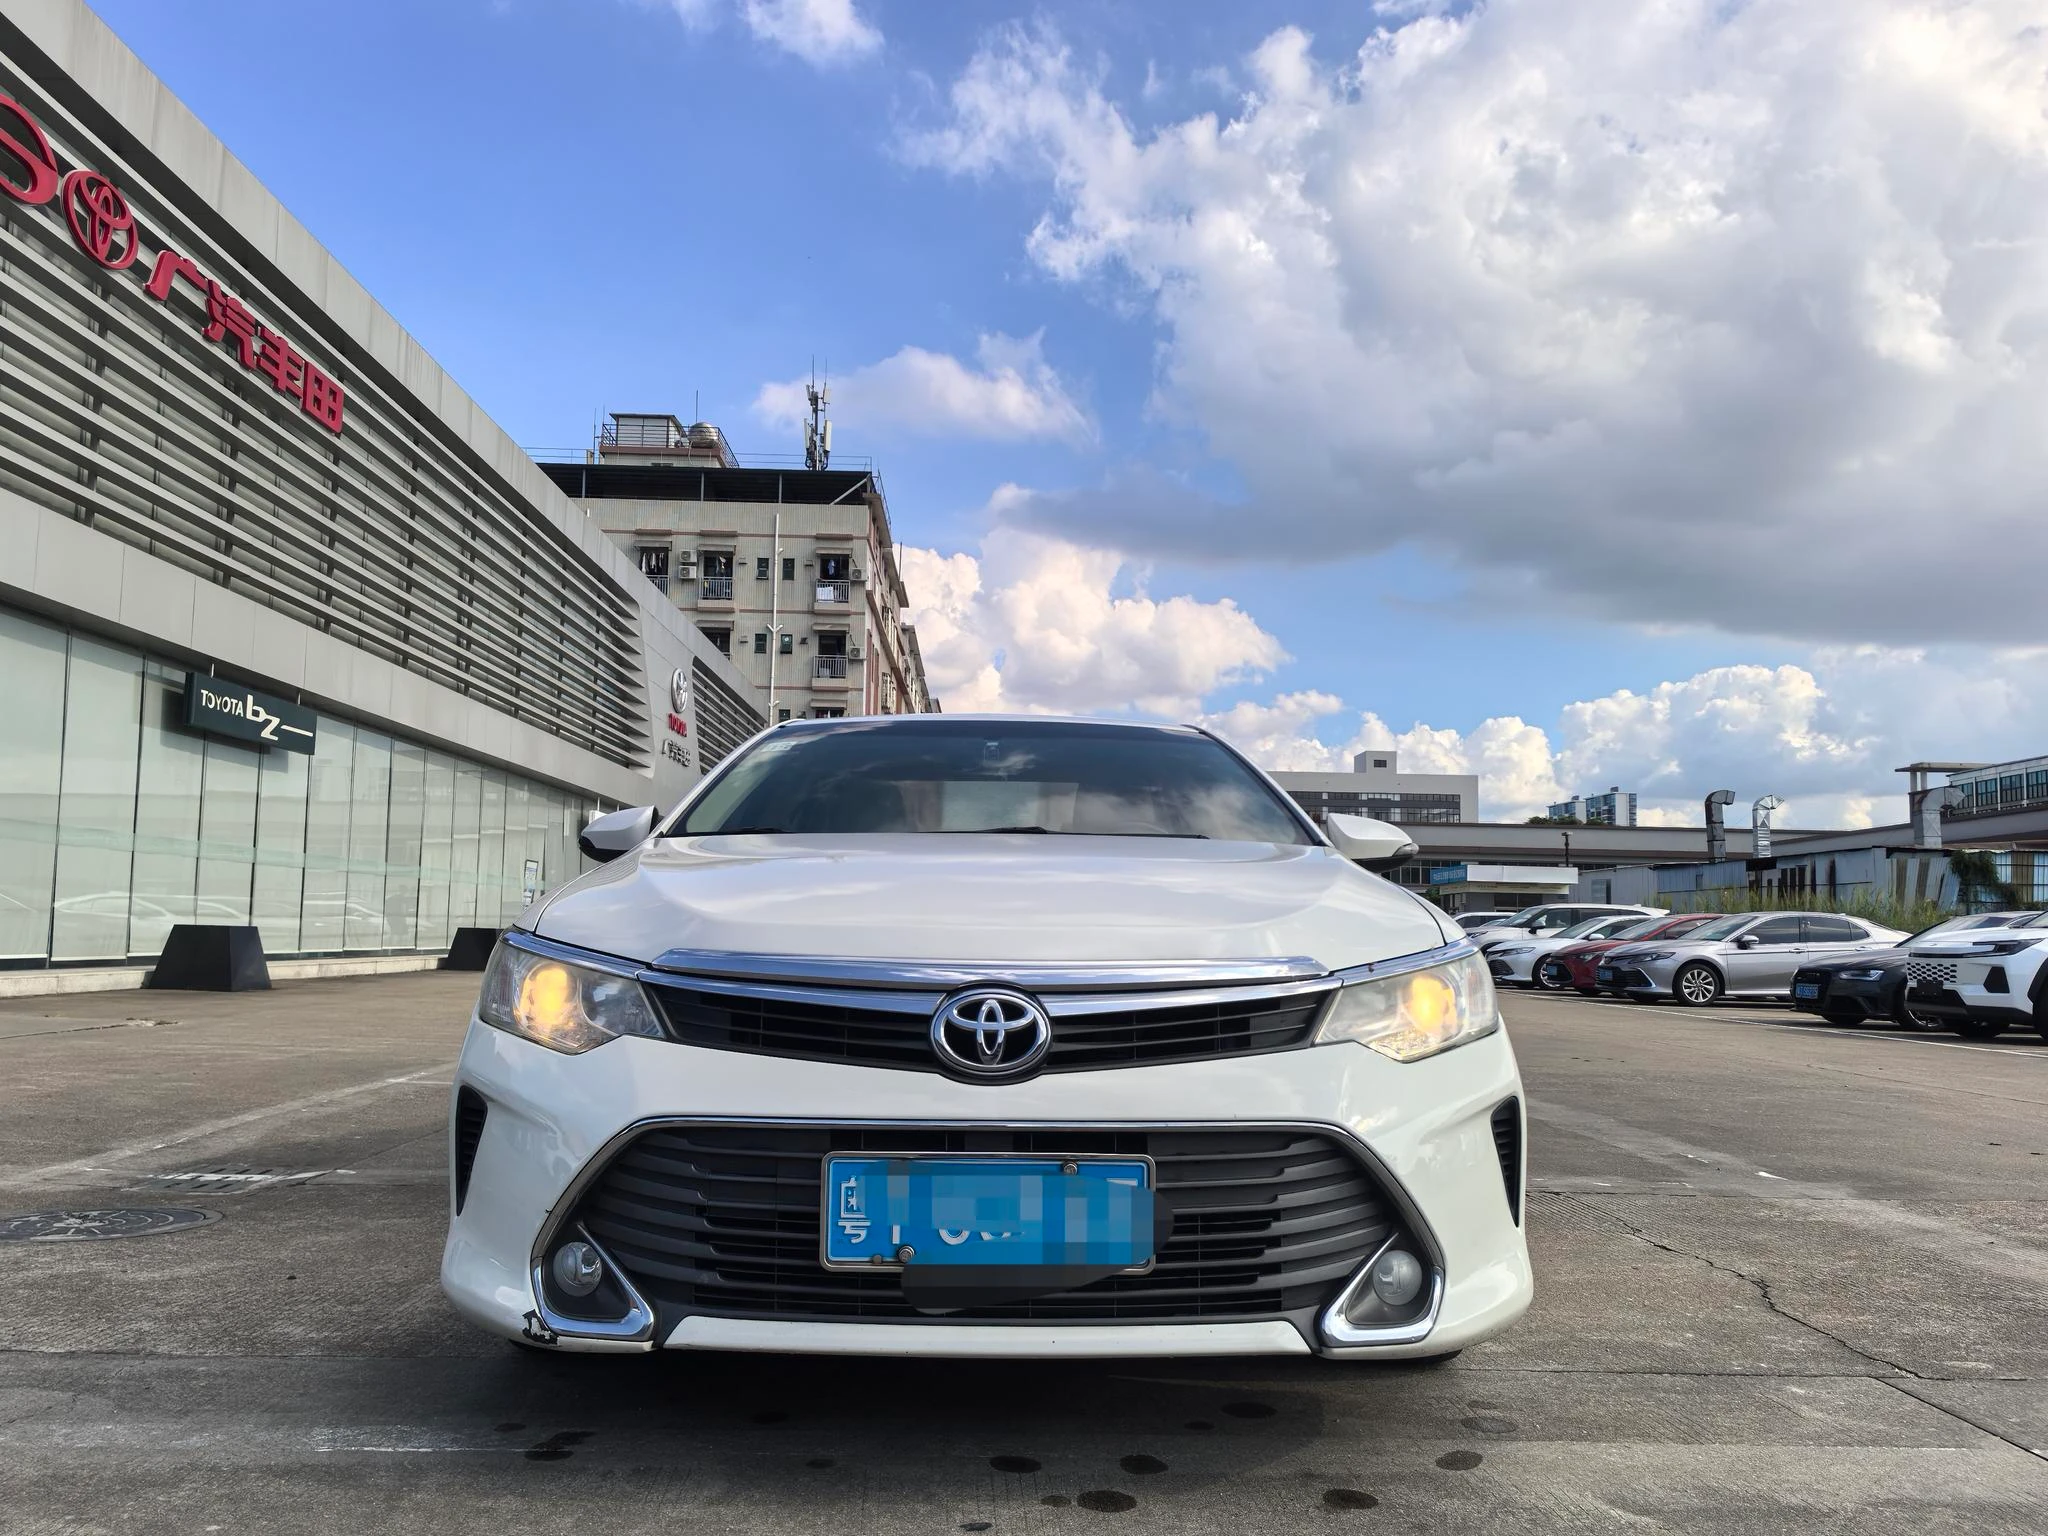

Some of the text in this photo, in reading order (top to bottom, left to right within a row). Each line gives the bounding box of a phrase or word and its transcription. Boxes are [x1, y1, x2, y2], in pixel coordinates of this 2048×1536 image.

[143, 249, 344, 438] 广汽丰田
[200, 689, 244, 718] TOYOTA
